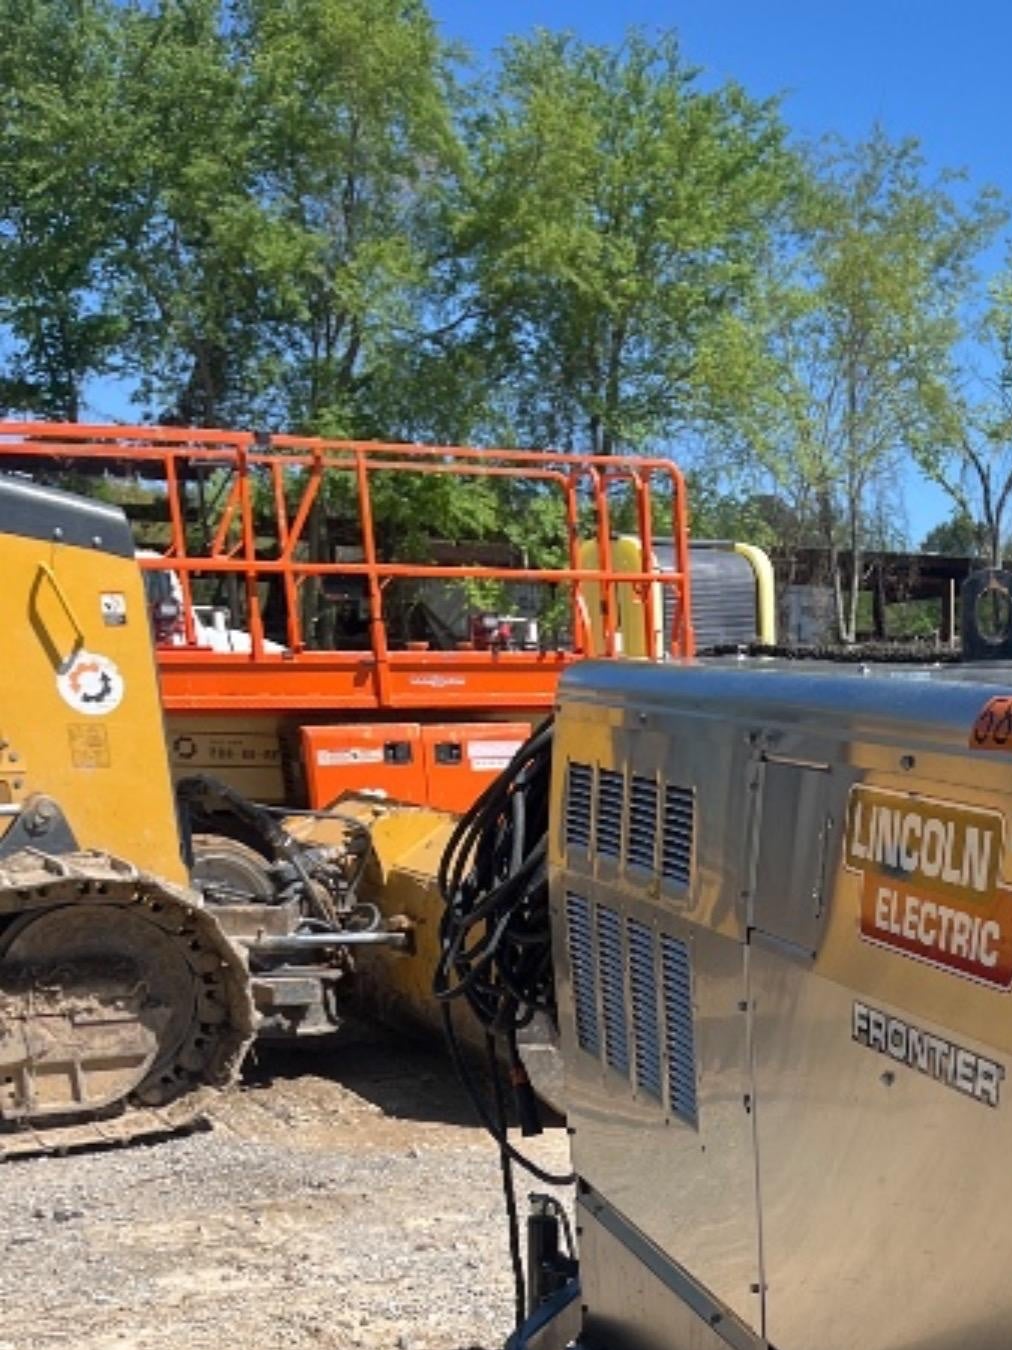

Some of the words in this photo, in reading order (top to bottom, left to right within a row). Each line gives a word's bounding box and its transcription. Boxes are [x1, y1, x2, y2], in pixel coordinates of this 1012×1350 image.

[851, 802, 994, 891] LINCOLN
[874, 887, 1001, 968] ELECTRIC
[851, 1000, 1006, 1109] FRONTIER
